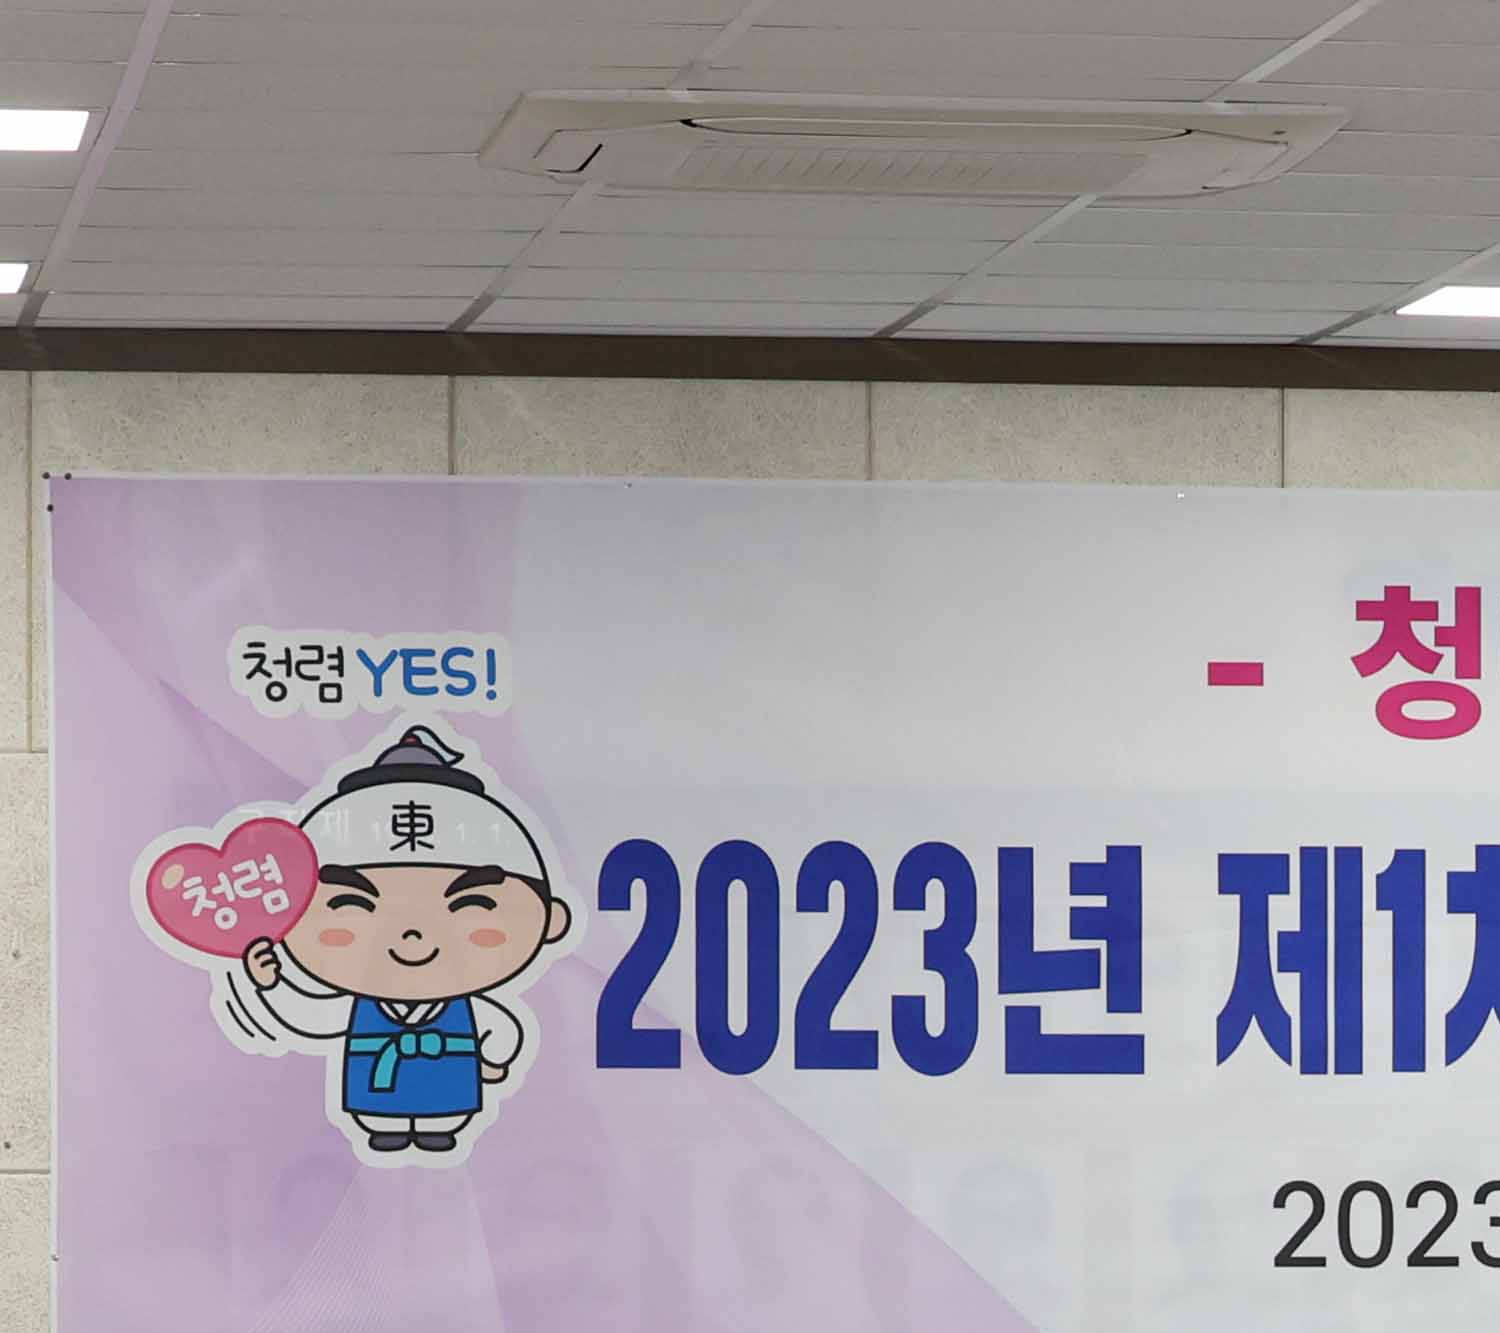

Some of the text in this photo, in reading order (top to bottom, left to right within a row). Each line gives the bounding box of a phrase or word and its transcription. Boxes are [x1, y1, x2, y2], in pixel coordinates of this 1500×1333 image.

[243, 641, 498, 703] 청렴 YES!
[390, 800, 435, 852] 東
[182, 853, 291, 931] 청렴
[597, 838, 1145, 1077] 2023년
